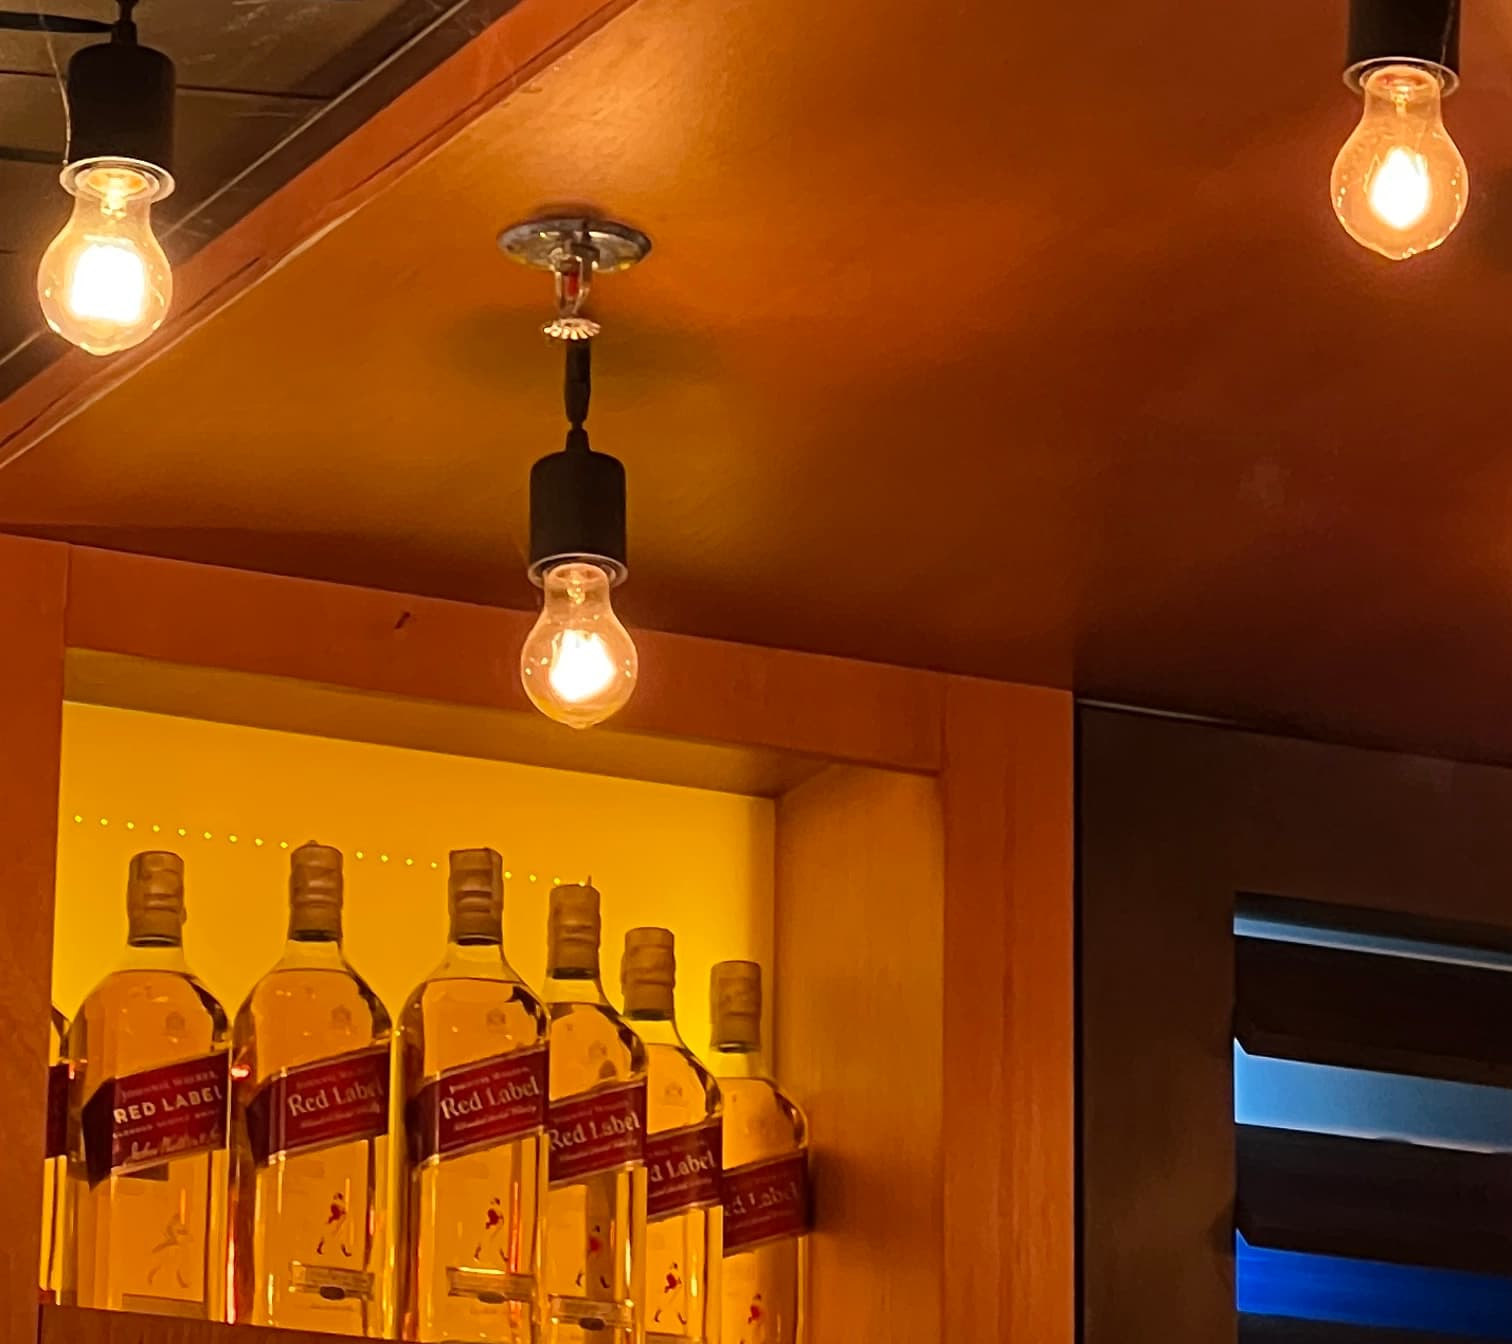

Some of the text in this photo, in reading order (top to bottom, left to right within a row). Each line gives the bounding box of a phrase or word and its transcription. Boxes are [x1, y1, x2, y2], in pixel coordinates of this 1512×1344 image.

[113, 1085, 222, 1124] RED LABEL
[287, 1089, 329, 1116] Red
[332, 1076, 383, 1105] Label
[440, 1091, 483, 1119] Red
[485, 1075, 540, 1106] Label
[548, 1122, 587, 1151] Red
[589, 1111, 640, 1139] Label
[665, 1150, 716, 1178] Label
[749, 1182, 799, 1208] Label
